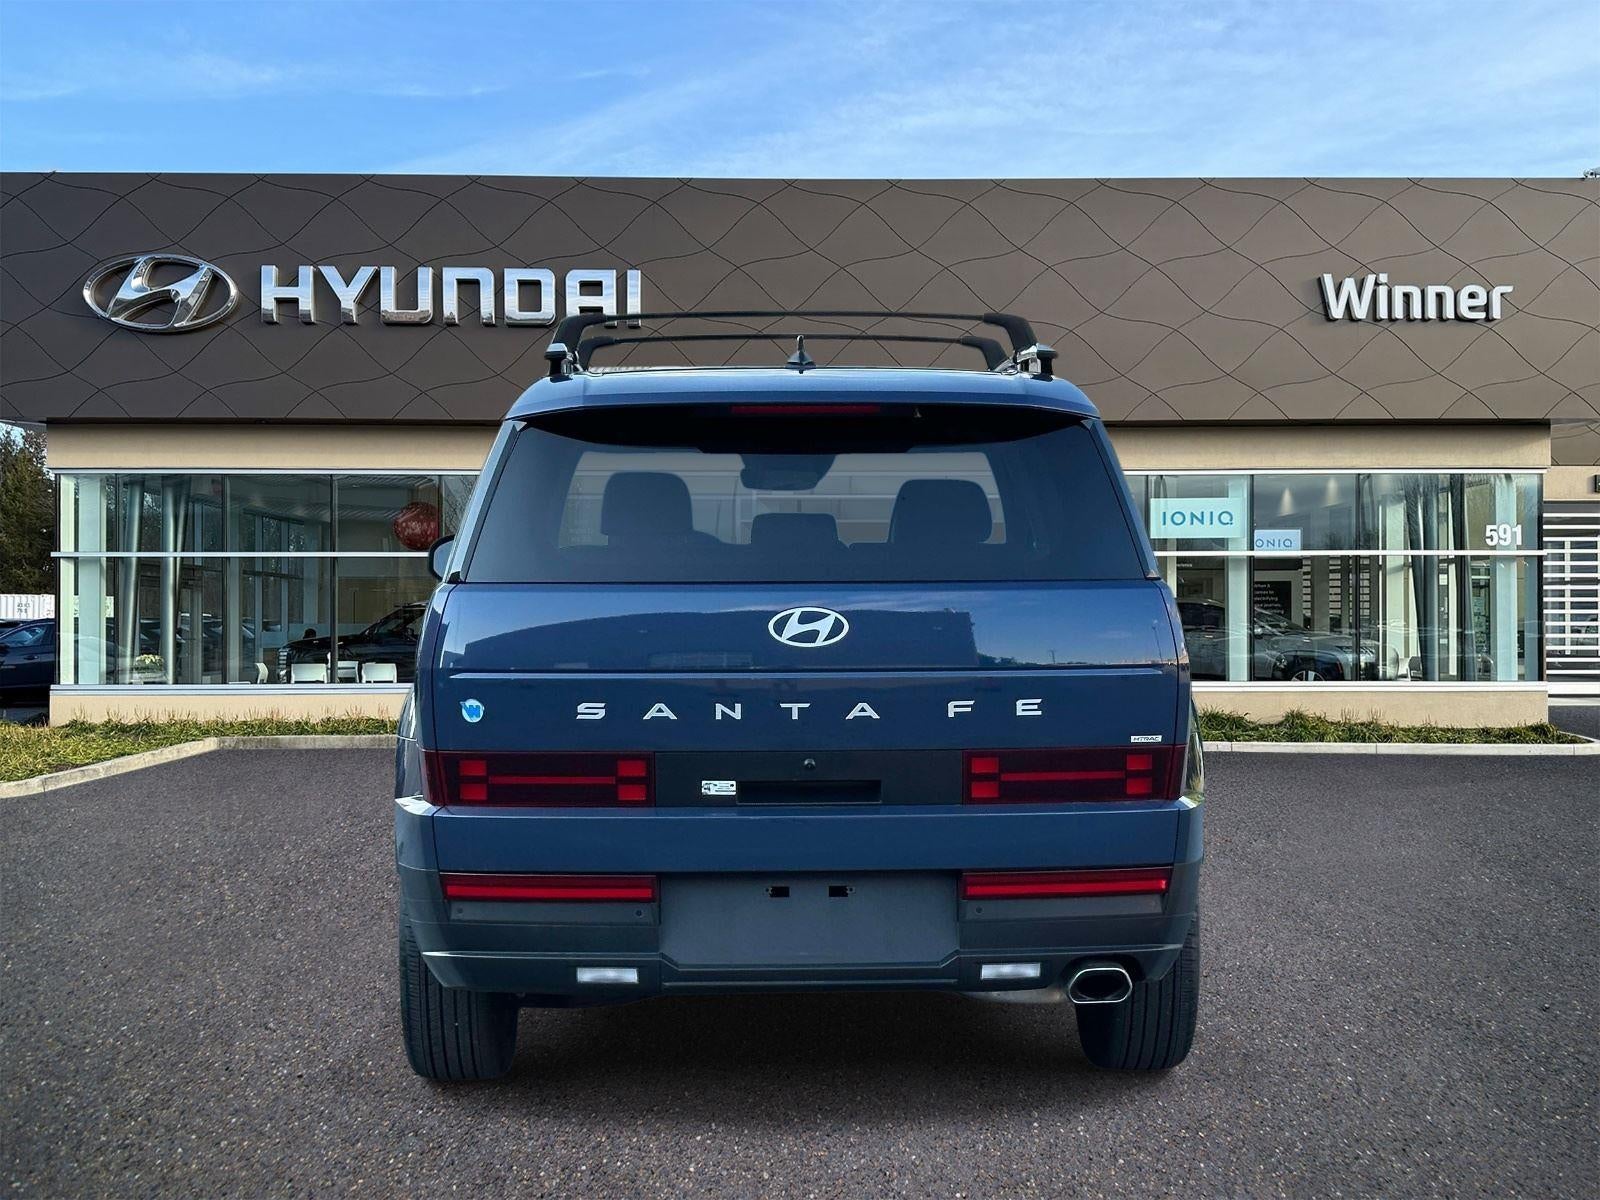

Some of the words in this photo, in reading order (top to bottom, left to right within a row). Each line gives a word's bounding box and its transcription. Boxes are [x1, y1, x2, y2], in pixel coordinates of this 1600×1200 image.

[260, 264, 642, 327] HYUNDAI
[1319, 272, 1514, 322] Winner
[1162, 511, 1234, 526] IONIQ
[1485, 523, 1522, 546] 591
[576, 702, 881, 720] SANTA
[947, 699, 1043, 718] FE
